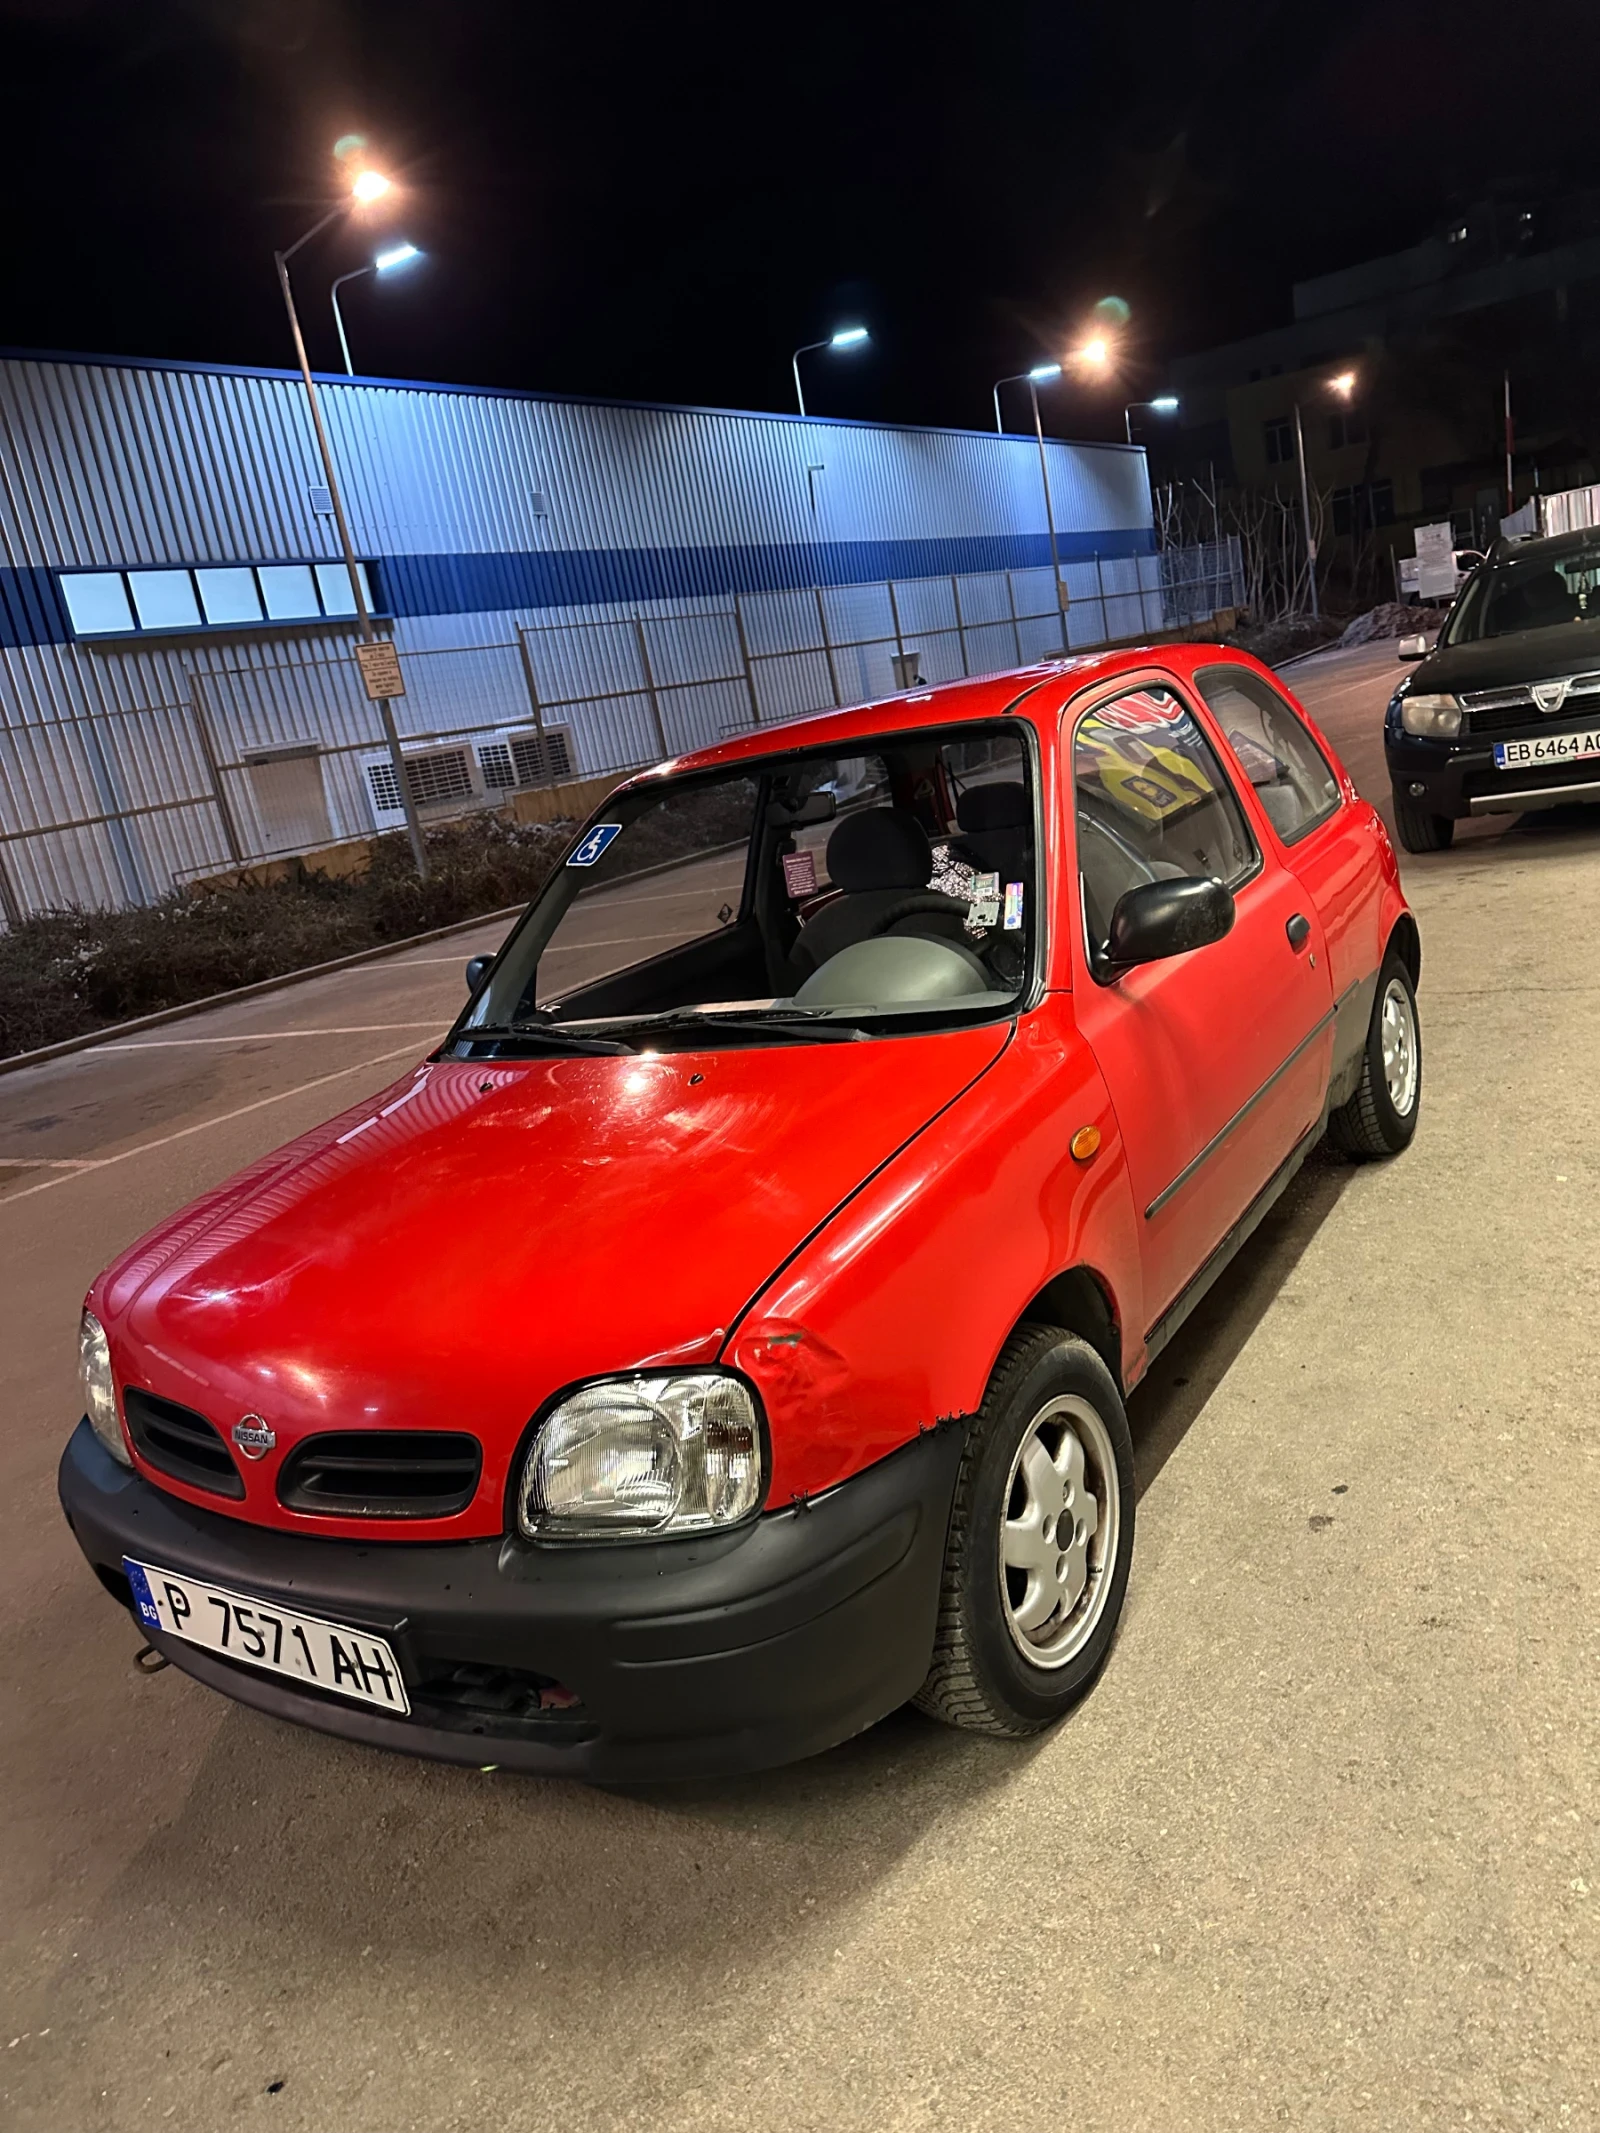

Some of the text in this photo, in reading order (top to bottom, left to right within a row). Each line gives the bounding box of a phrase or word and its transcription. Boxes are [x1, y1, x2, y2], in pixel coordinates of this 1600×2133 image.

[1506, 744, 1531, 762] EB
[1535, 736, 1579, 758] 6464
[235, 1430, 268, 1444] NISSAN
[140, 1601, 157, 1620] BG
[163, 1581, 395, 1701] P 7571 AH
